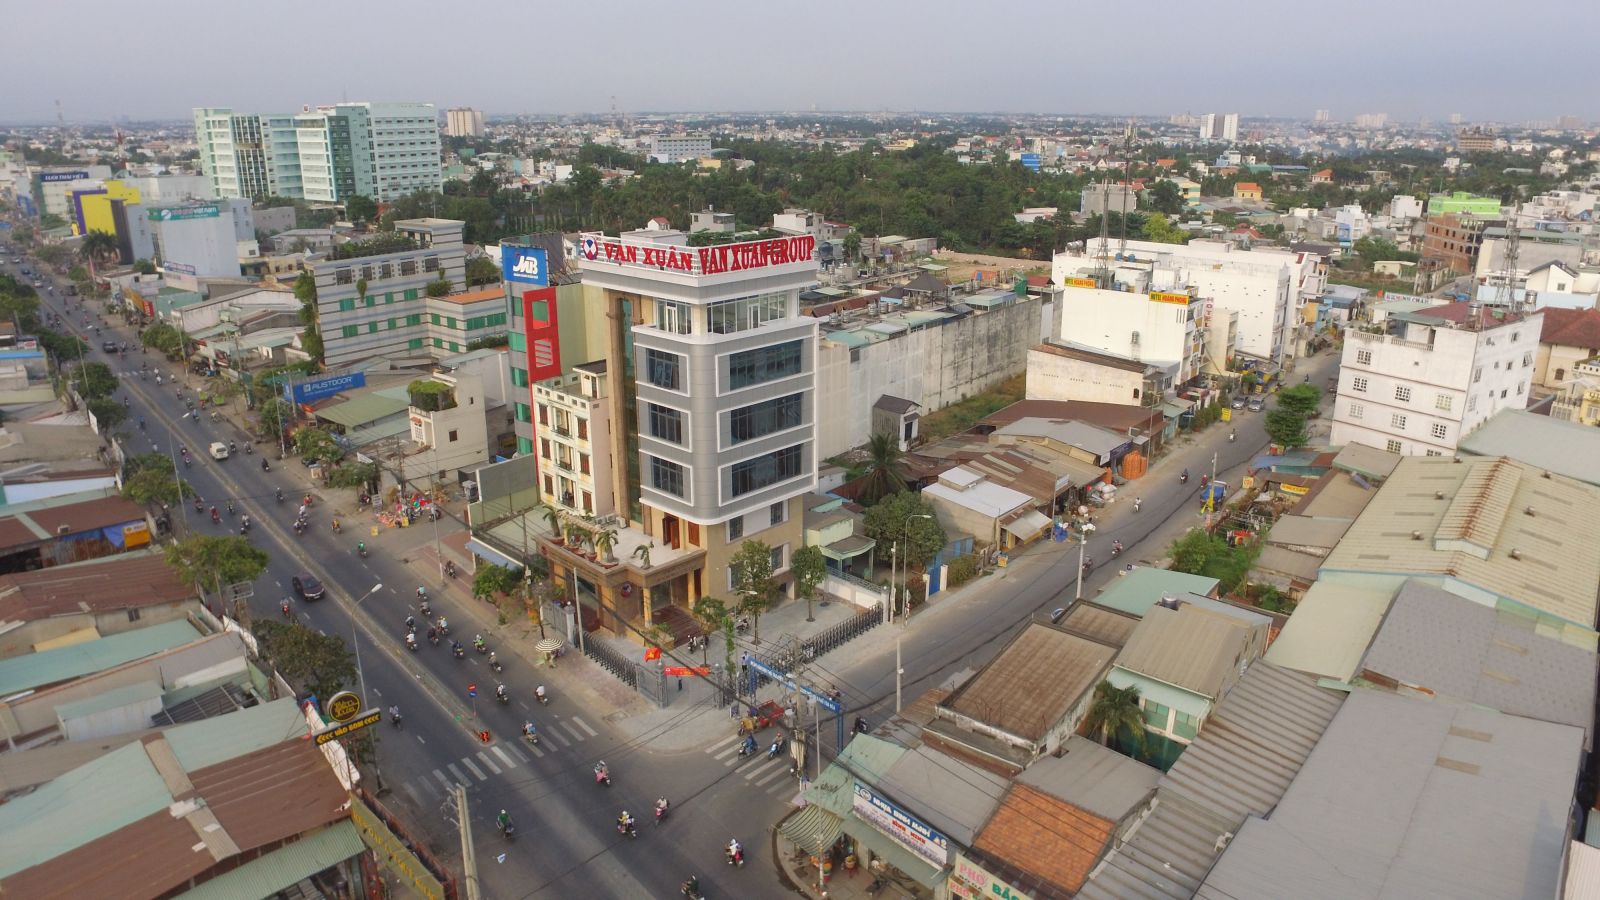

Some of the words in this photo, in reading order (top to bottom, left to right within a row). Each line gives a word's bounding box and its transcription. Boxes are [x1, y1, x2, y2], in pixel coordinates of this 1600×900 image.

[603, 242, 637, 266] VẠN
[642, 246, 692, 271] XUÂN
[698, 246, 729, 275] VAN
[731, 241, 768, 271] XUAN
[770, 236, 815, 266] GROUP
